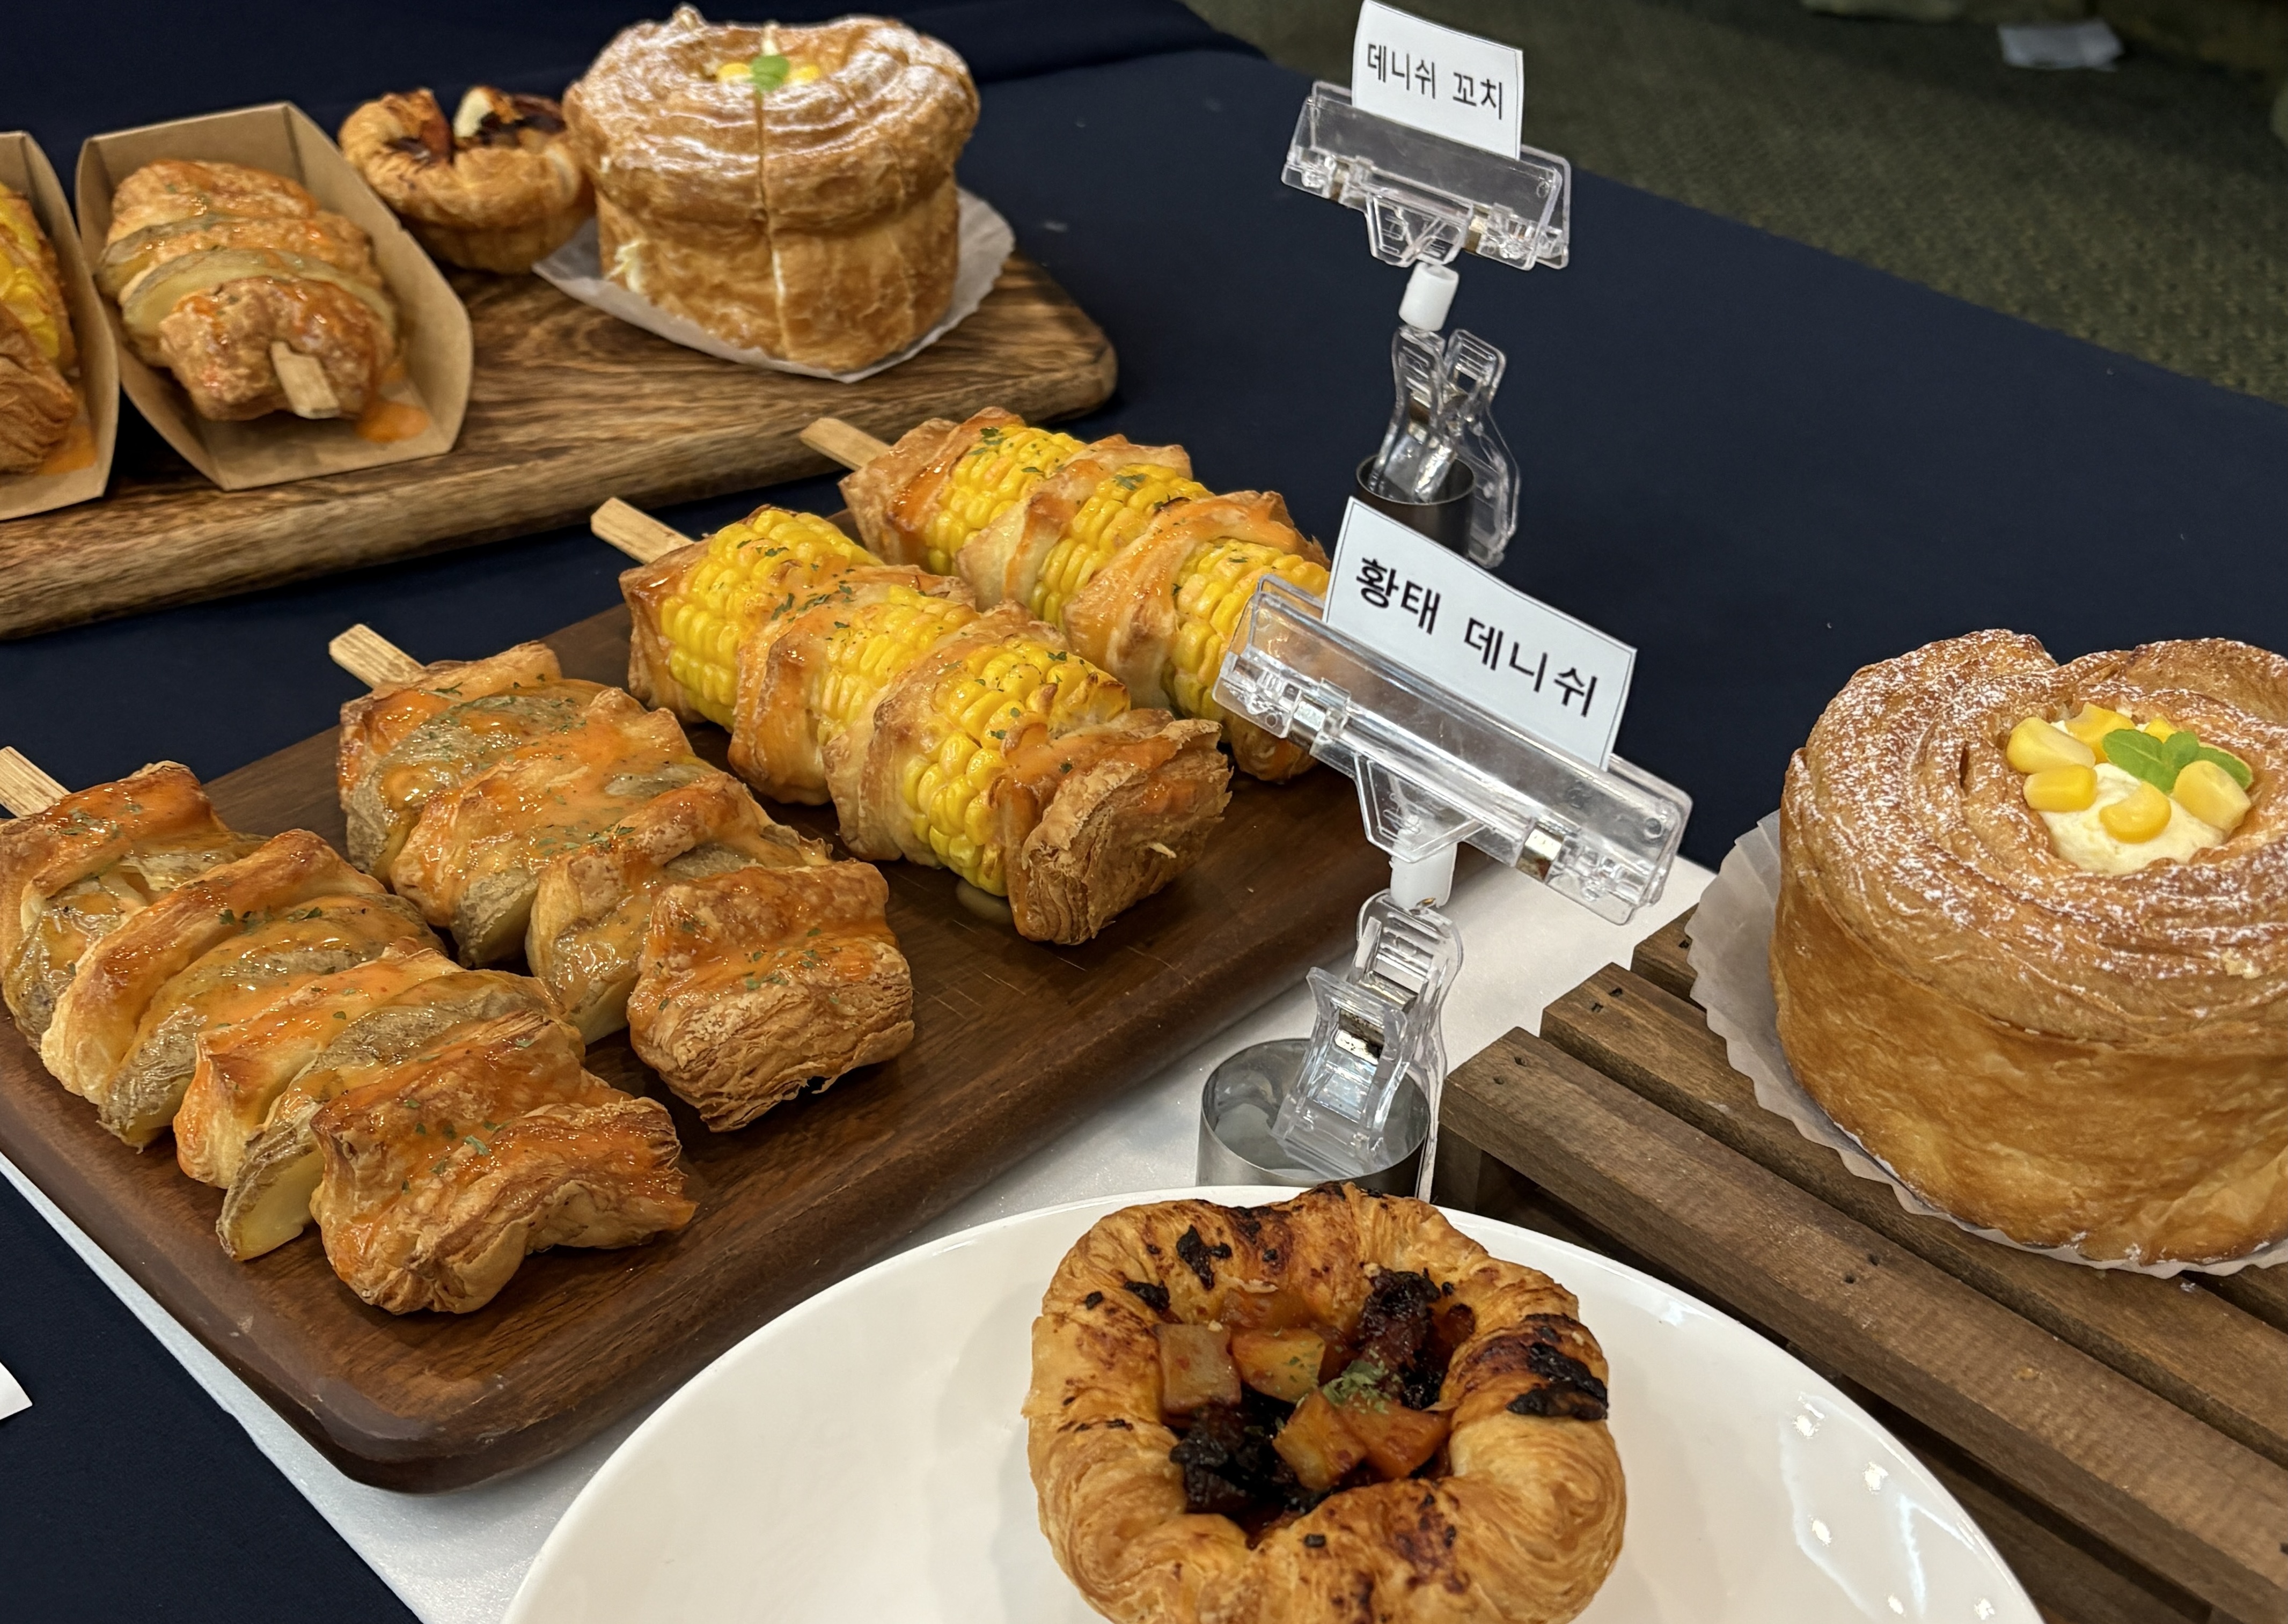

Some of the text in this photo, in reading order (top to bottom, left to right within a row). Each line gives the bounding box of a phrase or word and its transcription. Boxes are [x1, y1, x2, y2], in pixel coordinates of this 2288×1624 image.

[1367, 43, 1502, 120] 데니쉬 꼬치
[1356, 557, 1598, 718] 황태 데니쉬
